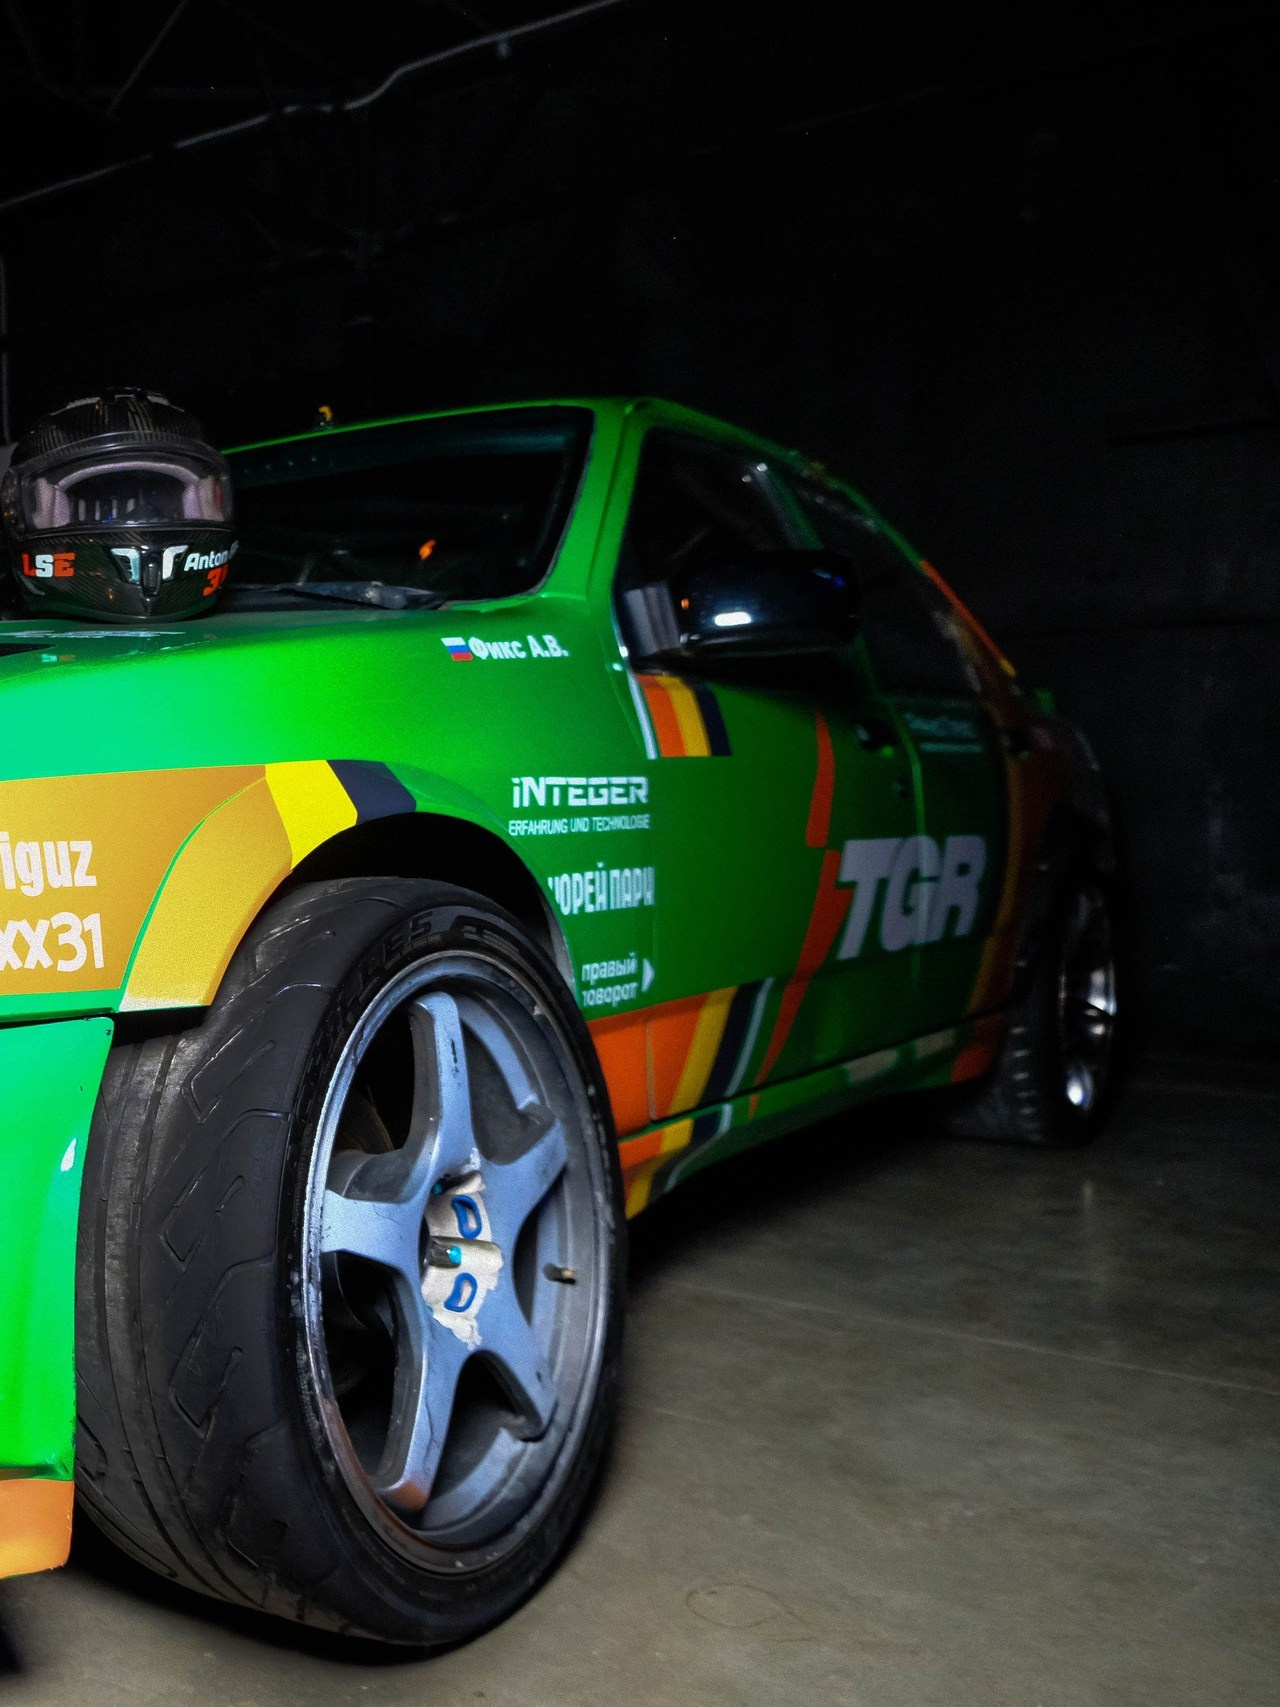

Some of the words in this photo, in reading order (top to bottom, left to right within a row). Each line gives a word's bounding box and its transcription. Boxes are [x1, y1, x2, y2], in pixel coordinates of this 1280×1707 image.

[467, 637, 527, 660] Фикс
[526, 634, 569, 658] А.В.
[508, 818, 568, 836] ERFAHRUNG
[570, 816, 590, 832] UND
[591, 813, 651, 831] TECHNOLOGIE
[836, 834, 987, 961] TGR
[581, 951, 639, 985] правый
